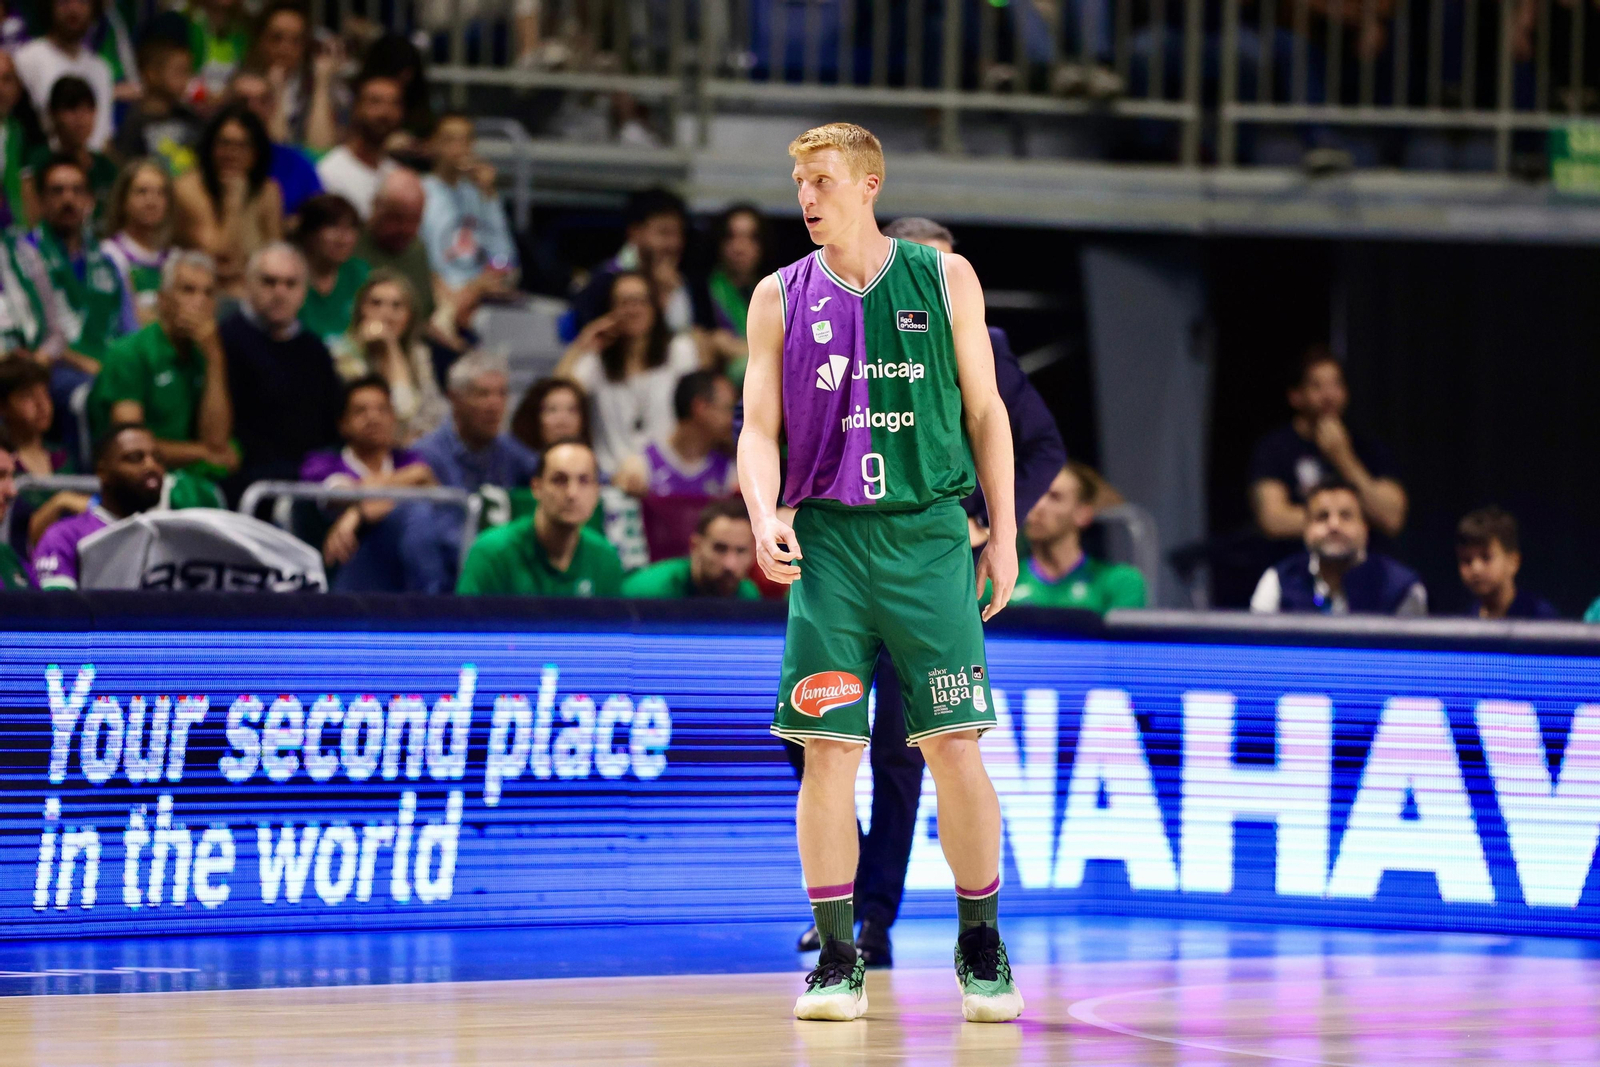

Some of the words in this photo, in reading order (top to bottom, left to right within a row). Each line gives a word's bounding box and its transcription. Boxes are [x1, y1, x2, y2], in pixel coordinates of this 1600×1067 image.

[900, 316, 912, 324] liga
[900, 322, 926, 330] endesa
[841, 404, 915, 433] málaga
[861, 452, 886, 500] 9
[928, 668, 947, 677] sabor
[796, 674, 861, 707] famadesa
[45, 663, 209, 785] Your
[218, 663, 478, 783] second
[483, 663, 672, 807] place
[33, 797, 101, 910] in
[123, 795, 236, 910] the
[257, 790, 463, 905] world
